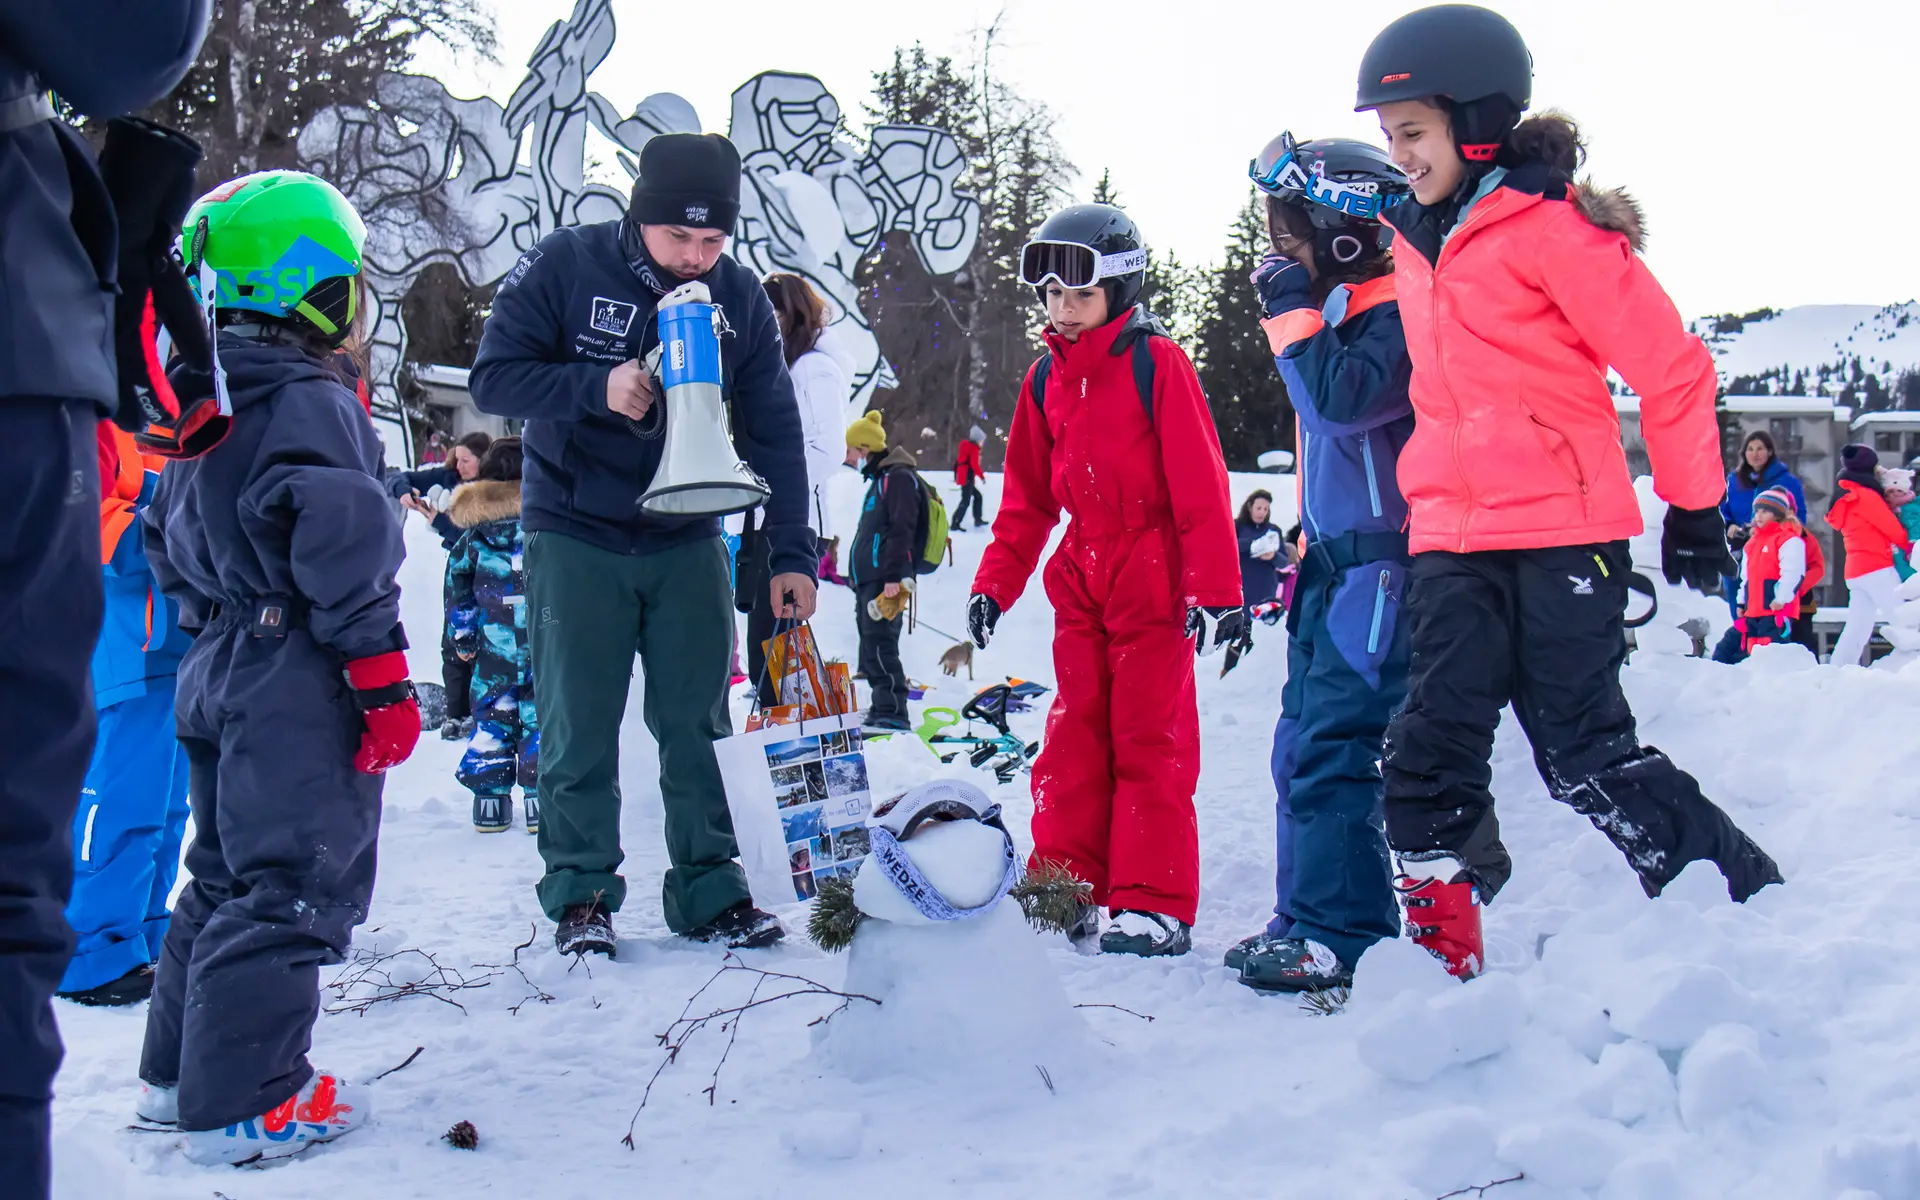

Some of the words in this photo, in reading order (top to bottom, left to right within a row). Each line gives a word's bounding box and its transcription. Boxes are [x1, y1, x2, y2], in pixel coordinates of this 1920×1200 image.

[1124, 254, 1145, 268] WED
[597, 307, 626, 326] flaine
[586, 350, 626, 361] CUPRA
[882, 847, 926, 902] WEDZE
